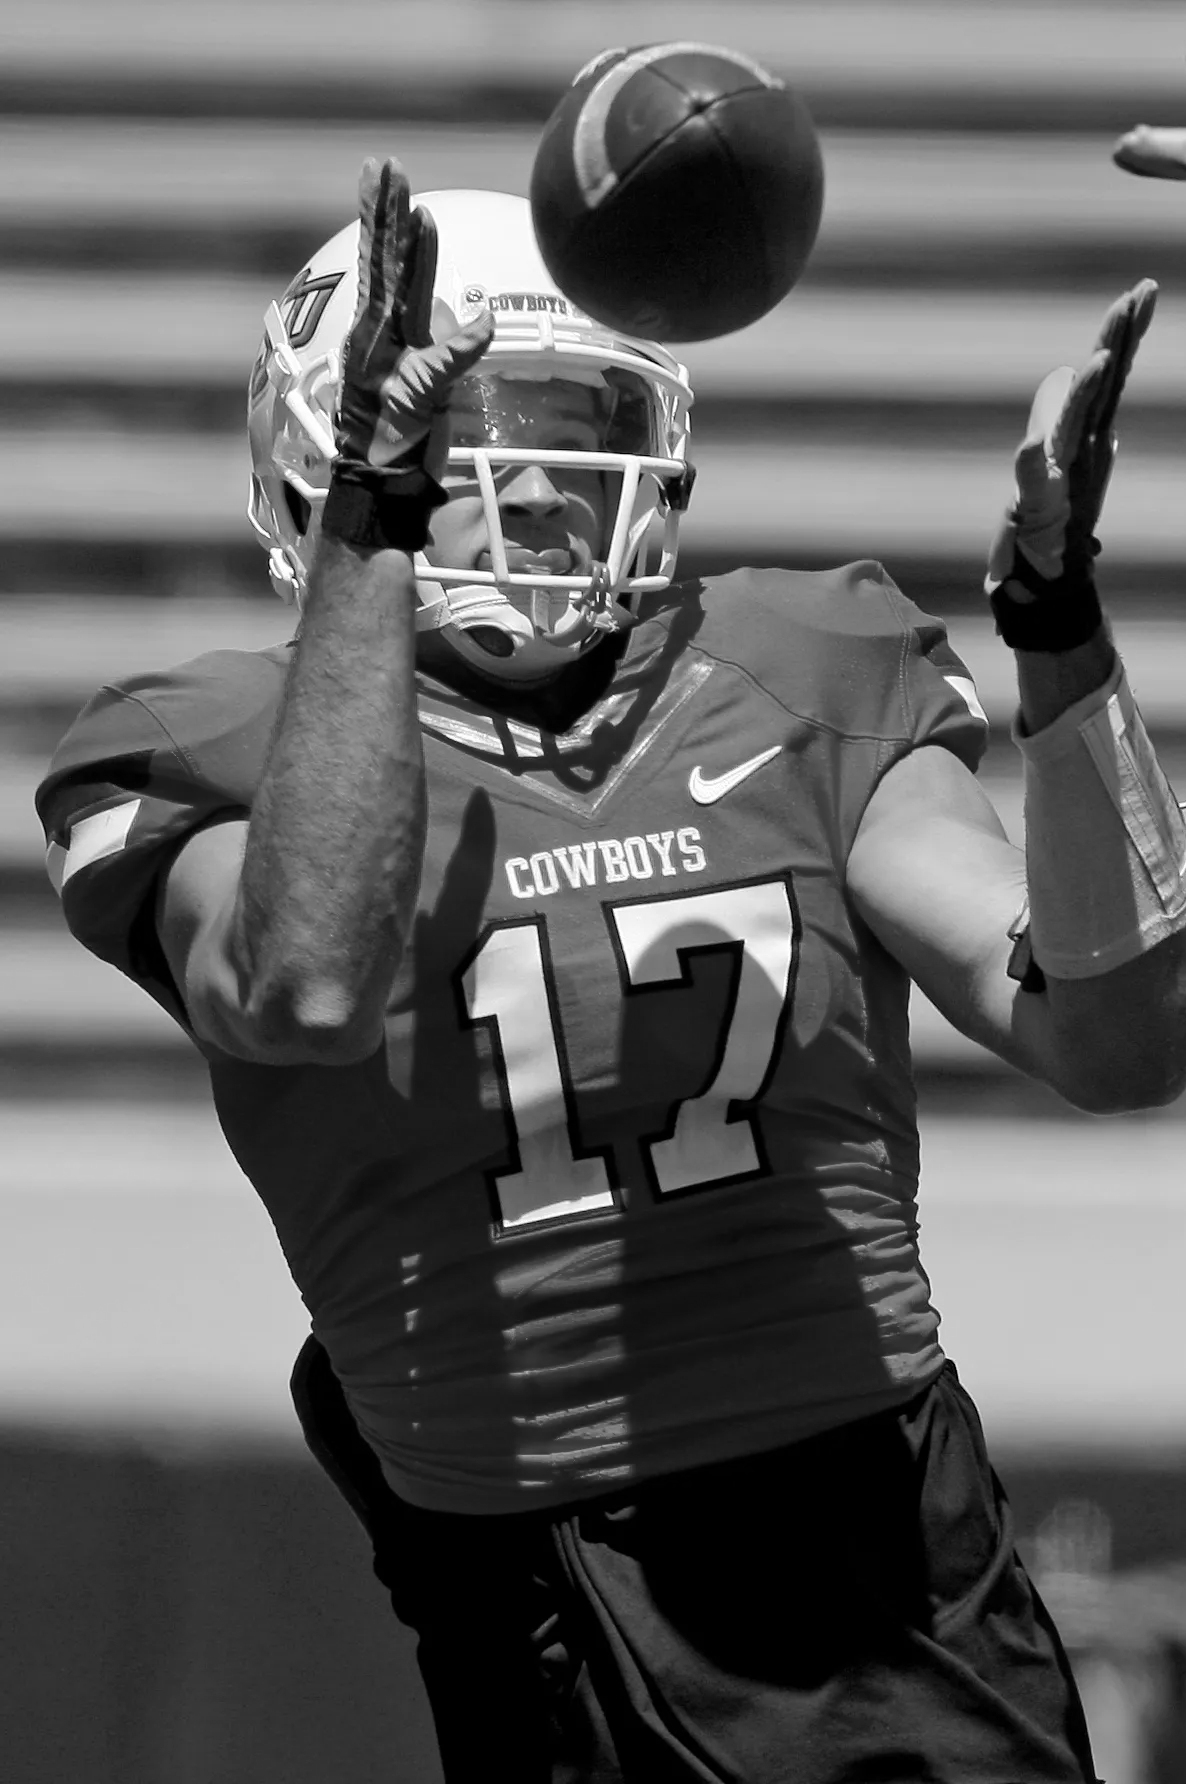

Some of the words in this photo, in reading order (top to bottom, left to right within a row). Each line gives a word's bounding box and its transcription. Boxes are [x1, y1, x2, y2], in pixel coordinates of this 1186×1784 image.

[489, 294, 567, 314] COWBOYS
[504, 827, 706, 899] COWBOYS
[452, 871, 801, 1240] 17
